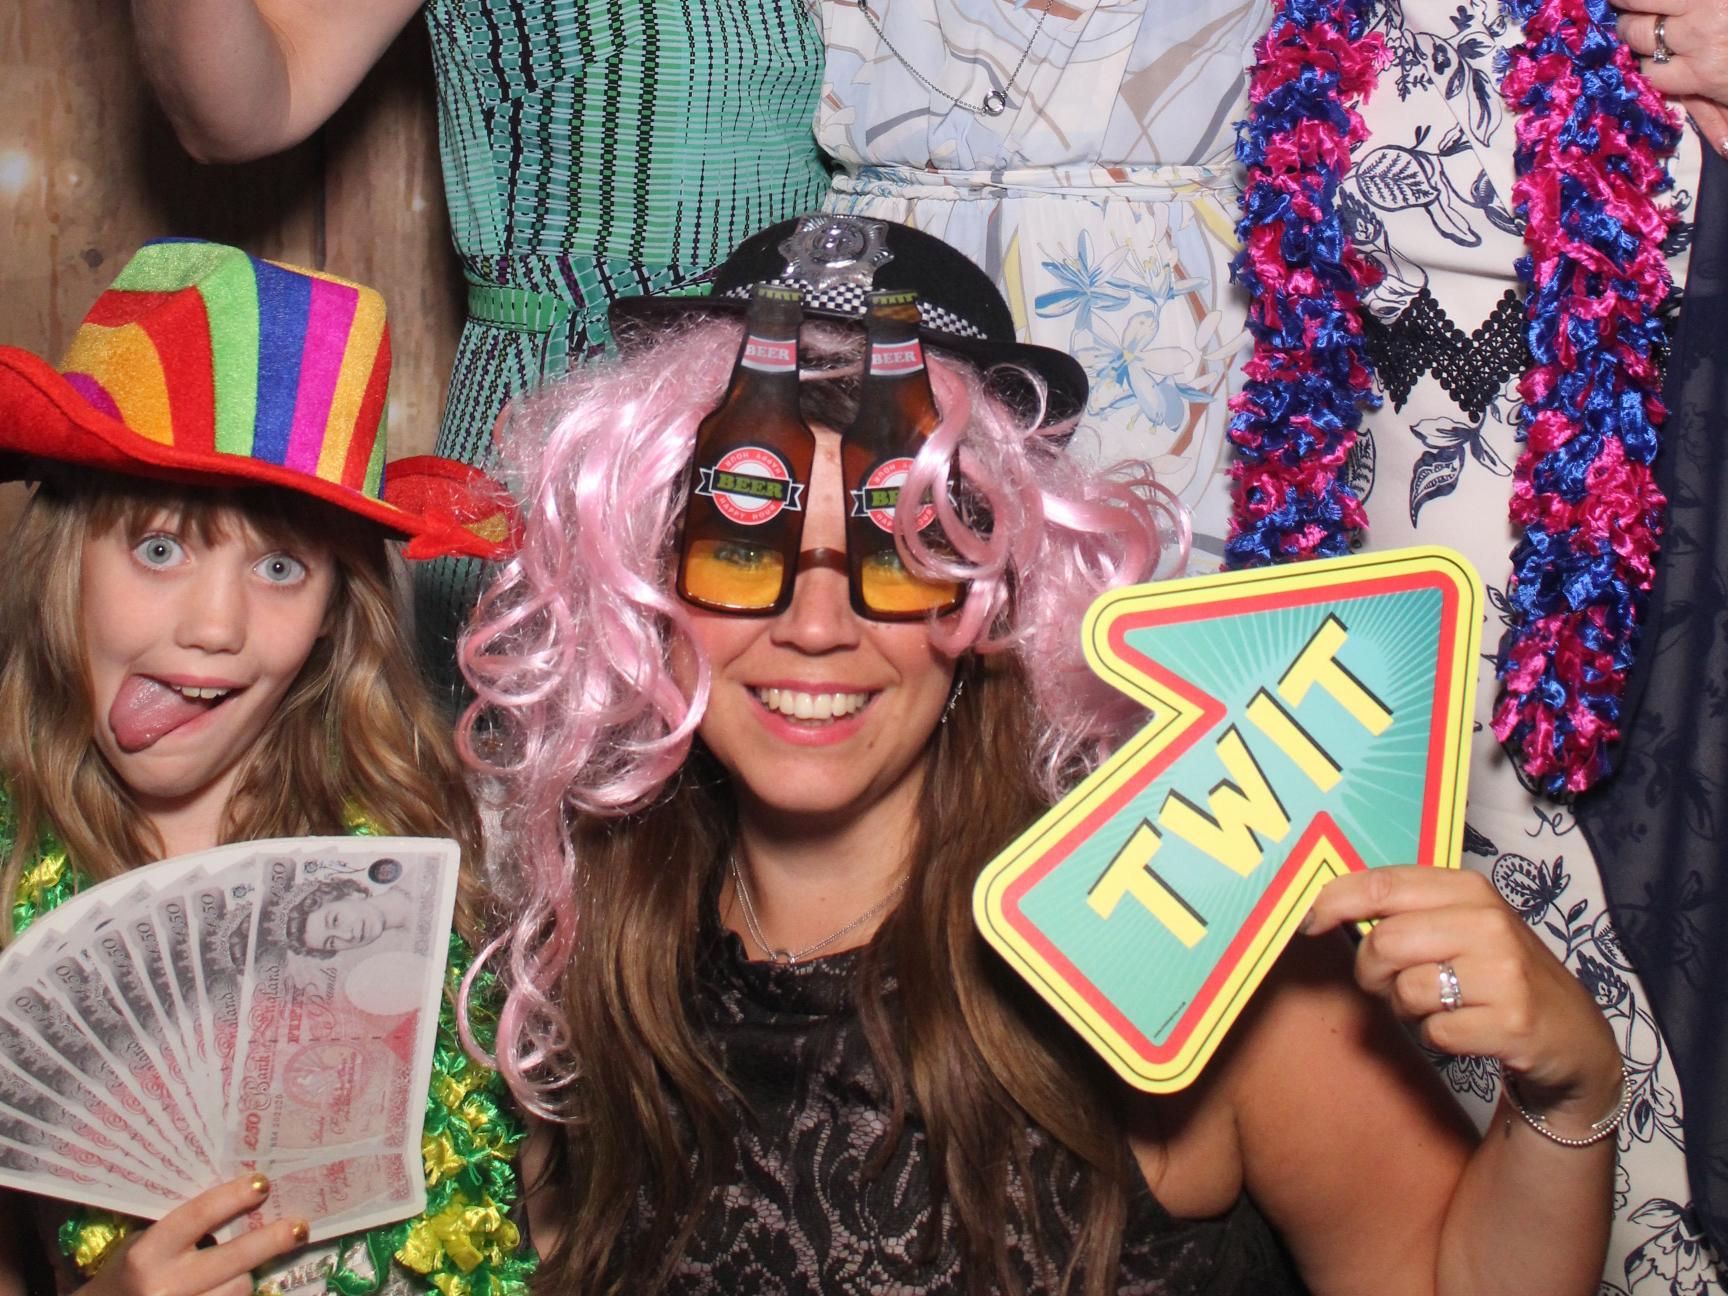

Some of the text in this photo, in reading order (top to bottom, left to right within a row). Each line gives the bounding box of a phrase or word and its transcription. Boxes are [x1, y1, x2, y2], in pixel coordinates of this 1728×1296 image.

[746, 343, 790, 361] BEER
[871, 350, 917, 364] BEER
[716, 472, 783, 499] BEER
[719, 495, 776, 520] HAPPY HOUR
[1086, 611, 1394, 950] TWIT
[248, 964, 281, 1040] England
[238, 1054, 272, 1111] Bank
[243, 1112, 262, 1152] £50
